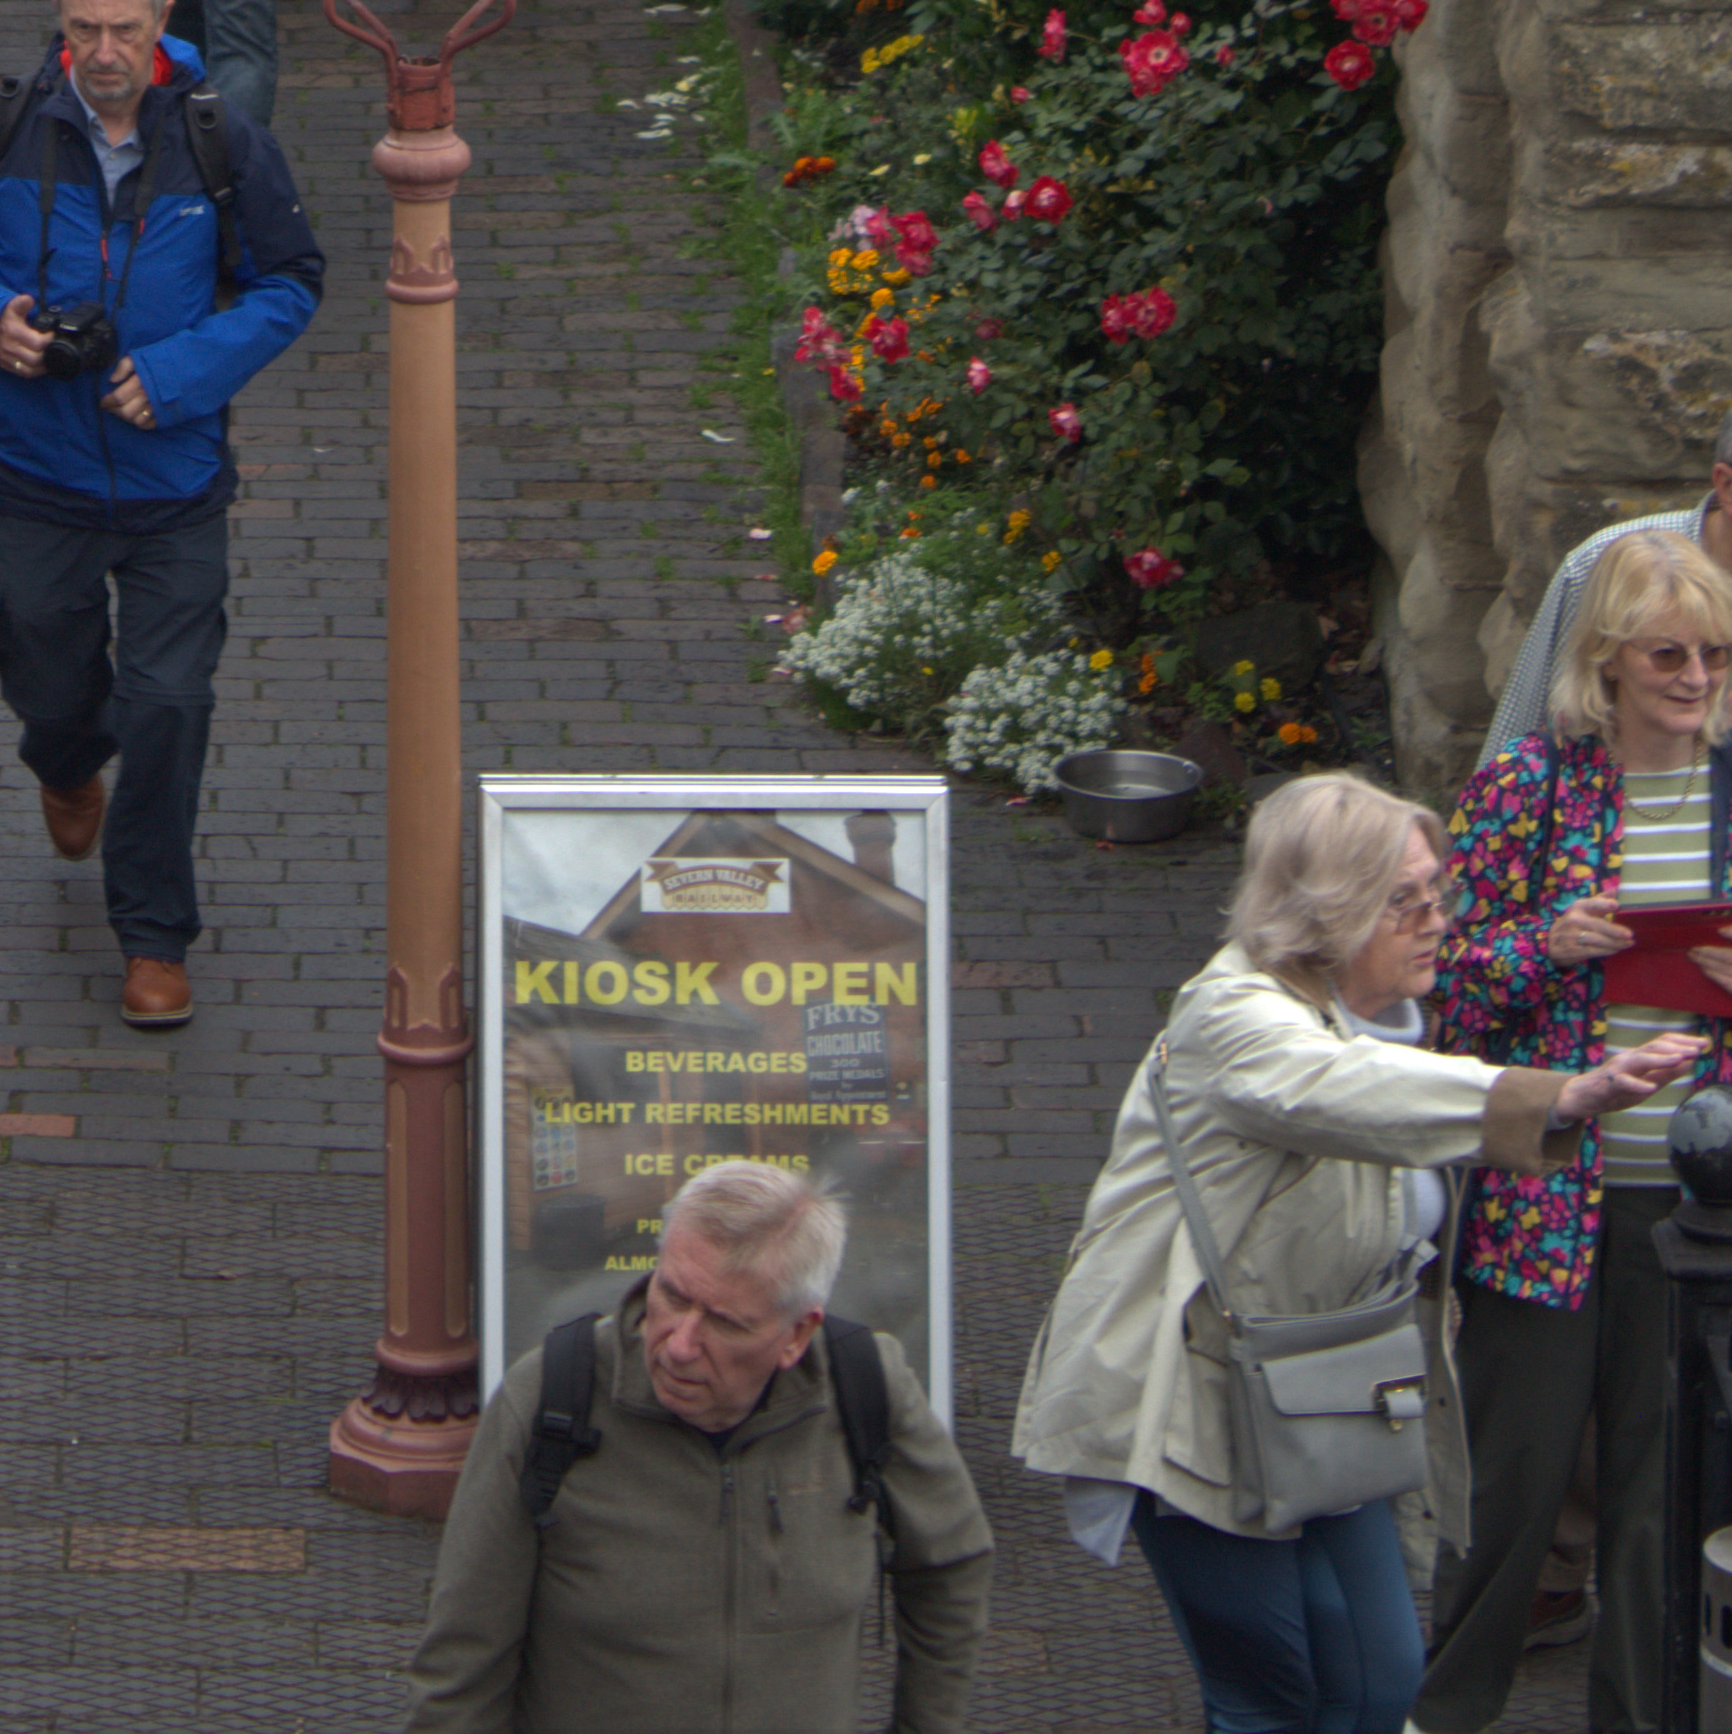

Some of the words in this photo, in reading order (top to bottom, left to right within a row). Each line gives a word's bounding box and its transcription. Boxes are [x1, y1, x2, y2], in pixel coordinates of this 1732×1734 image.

[663, 867, 714, 890] SEVERN
[716, 867, 765, 890] VALLEY
[675, 893, 755, 903] RAILWAY
[514, 960, 720, 1005] KIOSK
[741, 960, 919, 1006] OPEN
[625, 1050, 807, 1073] BEVERAGES
[544, 1102, 635, 1124] LIGHT
[645, 1102, 891, 1125] REFRESHMENTS
[625, 1153, 674, 1175] ICE
[684, 1153, 810, 1176] CMS
